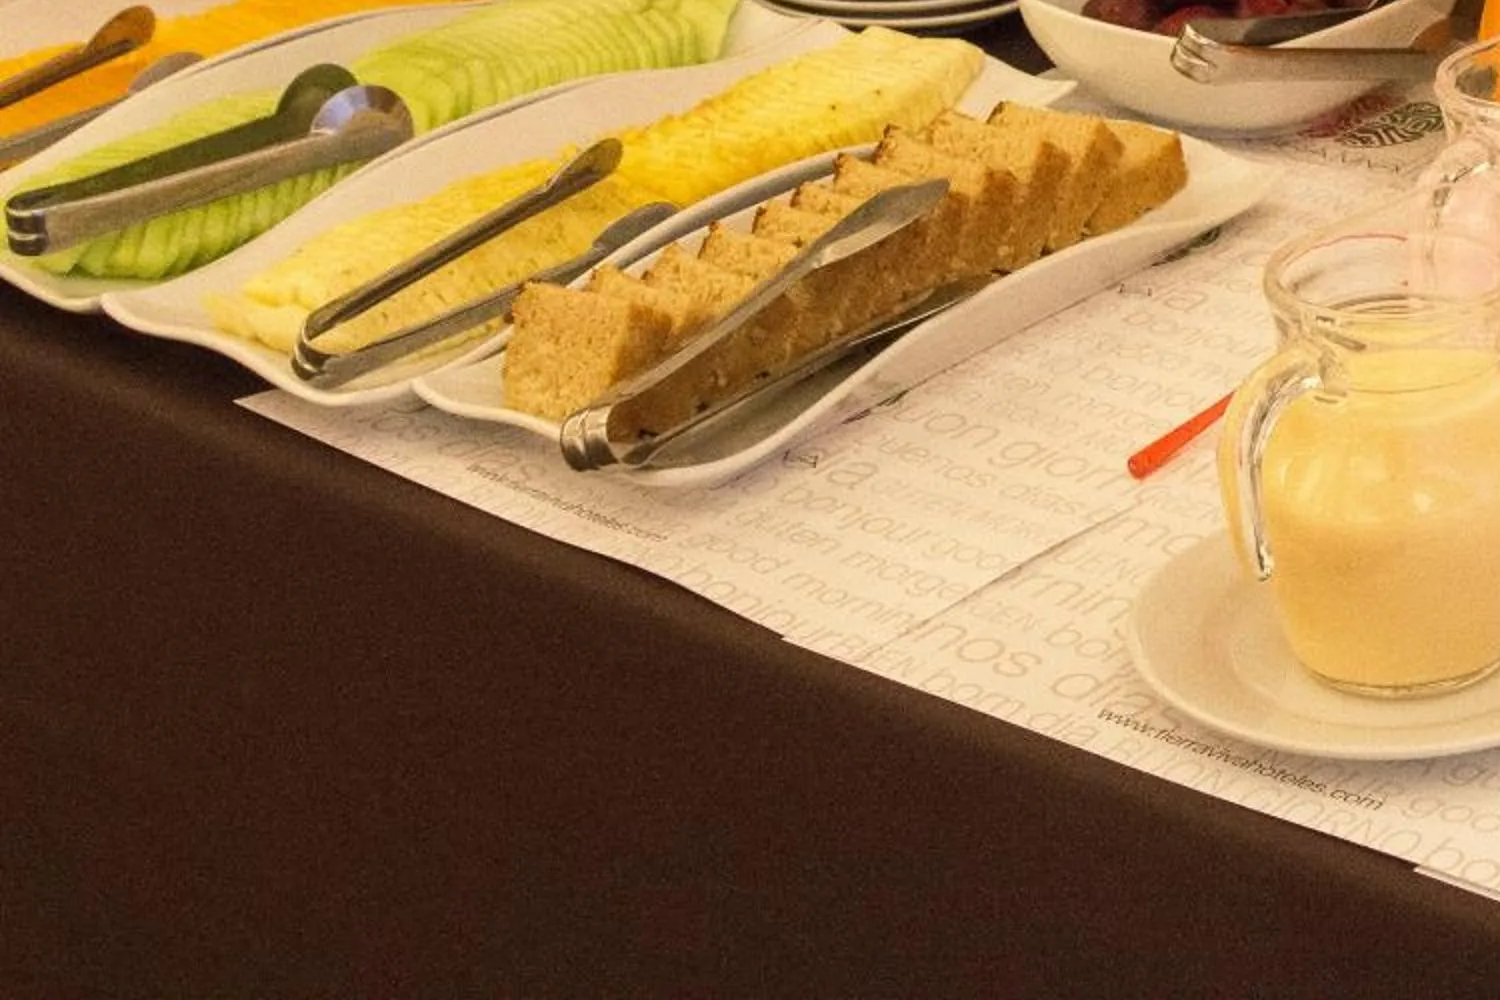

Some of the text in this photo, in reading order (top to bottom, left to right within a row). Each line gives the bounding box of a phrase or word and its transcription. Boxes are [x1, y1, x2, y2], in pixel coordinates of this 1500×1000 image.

[988, 441, 1128, 491] giorn
[780, 571, 916, 629] mornin
[838, 550, 972, 600] morge
[1097, 706, 1386, 812] www.tierravivahoteles.com
